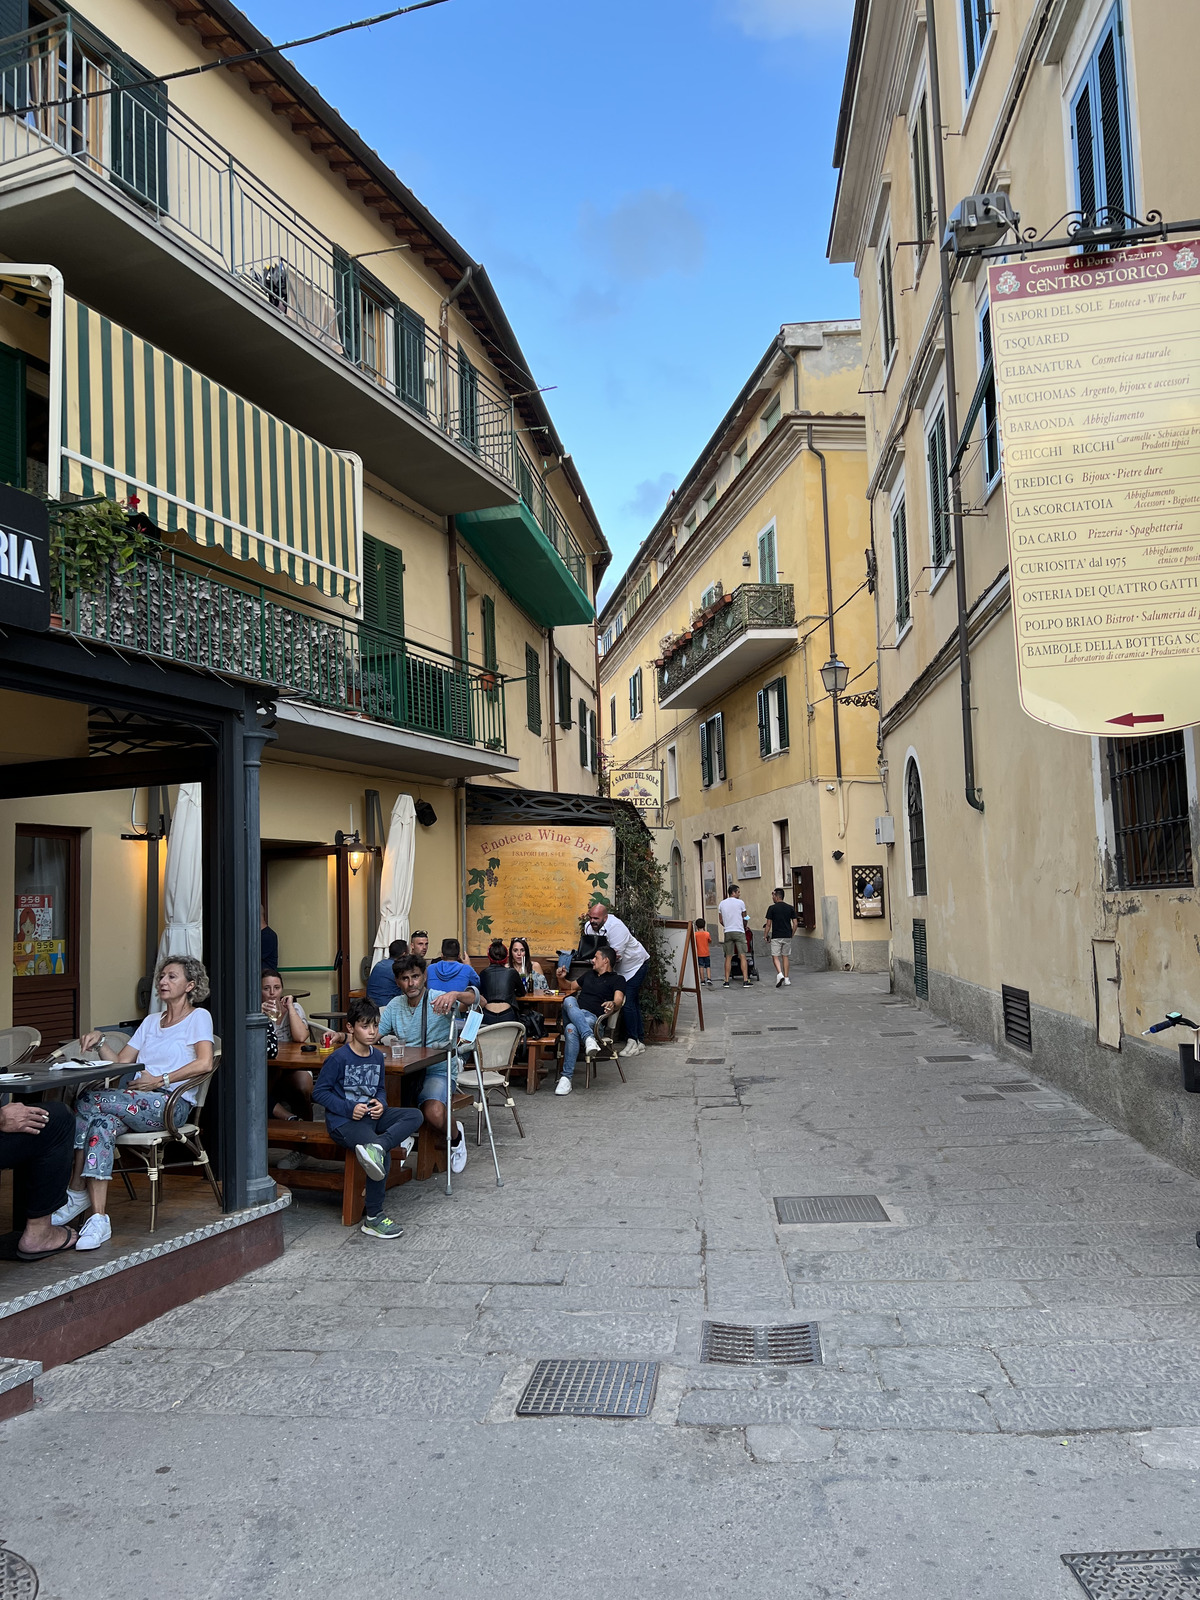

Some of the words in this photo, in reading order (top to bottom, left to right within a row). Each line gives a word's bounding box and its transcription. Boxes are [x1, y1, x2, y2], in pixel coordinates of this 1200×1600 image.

[1029, 262, 1071, 275] Comune
[1073, 258, 1084, 269] di
[1086, 254, 1117, 268] Porto
[1118, 250, 1163, 263] Azzurro
[1026, 272, 1093, 295] CENTRO
[1095, 262, 1169, 286] STORICO
[1007, 307, 1049, 322] SAPORI
[1051, 304, 1073, 317] DEL
[1075, 301, 1103, 314] SOLE
[1108, 297, 1141, 310] Enoteca
[1147, 292, 1170, 305] Wine
[1172, 290, 1187, 301] bar
[1003, 331, 1070, 350] TSQUARED
[1005, 359, 1082, 378] ELBANATURA
[1091, 352, 1134, 366] Cosmetica
[1135, 347, 1172, 361] naturale
[1008, 387, 1076, 405] MUCHOMAS
[1080, 381, 1118, 398] Argento,
[1119, 379, 1146, 394] bijoux
[1147, 380, 1153, 389] e
[1154, 374, 1190, 389] accessori
[1009, 416, 1075, 433] BARAONDA
[1082, 410, 1145, 426] Abbigliamento
[1011, 445, 1063, 461] CHICCHI
[1072, 440, 1115, 455] RICCHI
[1116, 431, 1152, 444] Caramelle
[1157, 427, 1190, 439] Schiaccia
[1141, 436, 1170, 450] Prodotti
[1171, 436, 1190, 449] tipici
[1014, 474, 1063, 489] TREDICI
[1065, 473, 1074, 484] G
[1082, 472, 1111, 485] Bijoux
[1117, 467, 1142, 479] Pietre
[1143, 465, 1163, 476] dure
[1016, 505, 1031, 518] LA
[1033, 498, 1113, 516] SCORCIATOIA
[1124, 488, 1176, 501] Abbigliamento
[1134, 498, 1166, 509] Accessori
[1018, 532, 1035, 546] DA
[1037, 530, 1077, 544] CARLO
[1088, 526, 1123, 540] Pizzeria
[1129, 520, 1184, 538] Spaghetteria
[0, 529, 41, 587] RIA
[1020, 558, 1086, 574] CURIOSITA'
[1088, 557, 1103, 569] dal
[1105, 556, 1127, 570] 1975
[1142, 545, 1194, 557] Abbigliamento
[1157, 555, 1178, 565] etnico
[1023, 587, 1073, 603] OSTERIA
[1075, 586, 1096, 598] DEI
[1099, 580, 1157, 598] QUATTRO
[1160, 577, 1198, 591] GATTI
[1025, 618, 1063, 632] POLPO
[1066, 615, 1103, 628] BRIAO
[1105, 612, 1135, 625] Bistrot
[1141, 608, 1186, 622] Salumeria
[1187, 606, 1197, 618] di
[1027, 642, 1083, 657] BAMBOLE
[1085, 639, 1123, 653] DELLA
[1126, 634, 1182, 649] BOTTEGA
[1185, 632, 1200, 645] SC
[1064, 651, 1105, 663] Laboratorio
[1106, 651, 1113, 660] di
[1114, 649, 1145, 660] ceramica
[1151, 645, 1190, 657] Produzione
[614, 772, 634, 784] SAPORI
[635, 772, 645, 780] DEL
[645, 773, 660, 787] SOLE
[480, 831, 532, 855] Enoteca
[538, 828, 571, 845] Wine
[574, 836, 599, 856] Bar
